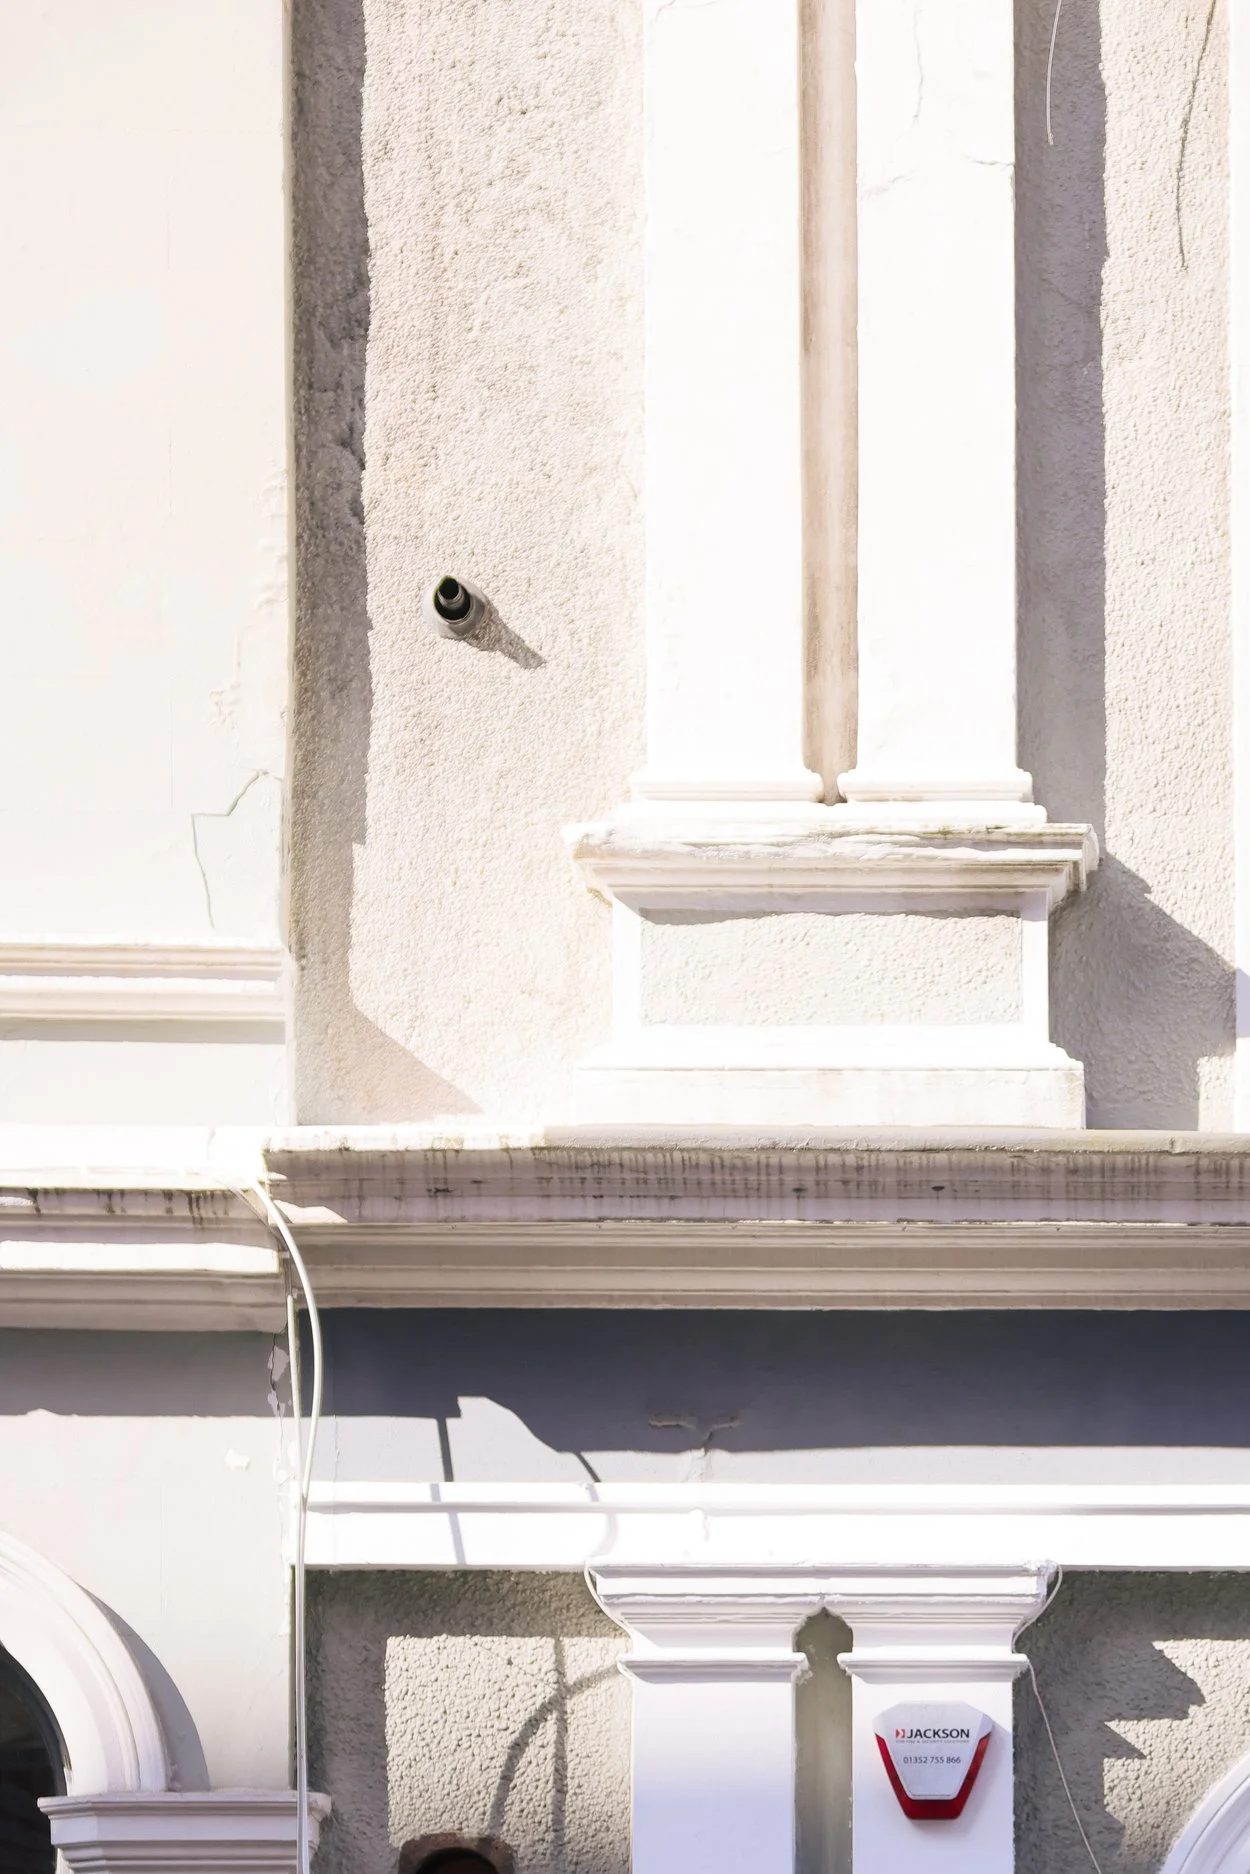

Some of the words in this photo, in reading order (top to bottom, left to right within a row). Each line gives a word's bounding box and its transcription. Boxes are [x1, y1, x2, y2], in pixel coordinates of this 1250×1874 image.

[907, 1728, 970, 1739] JACKSON
[903, 1756, 928, 1764] 01352
[930, 1756, 944, 1764] 755
[946, 1756, 961, 1764] 866
